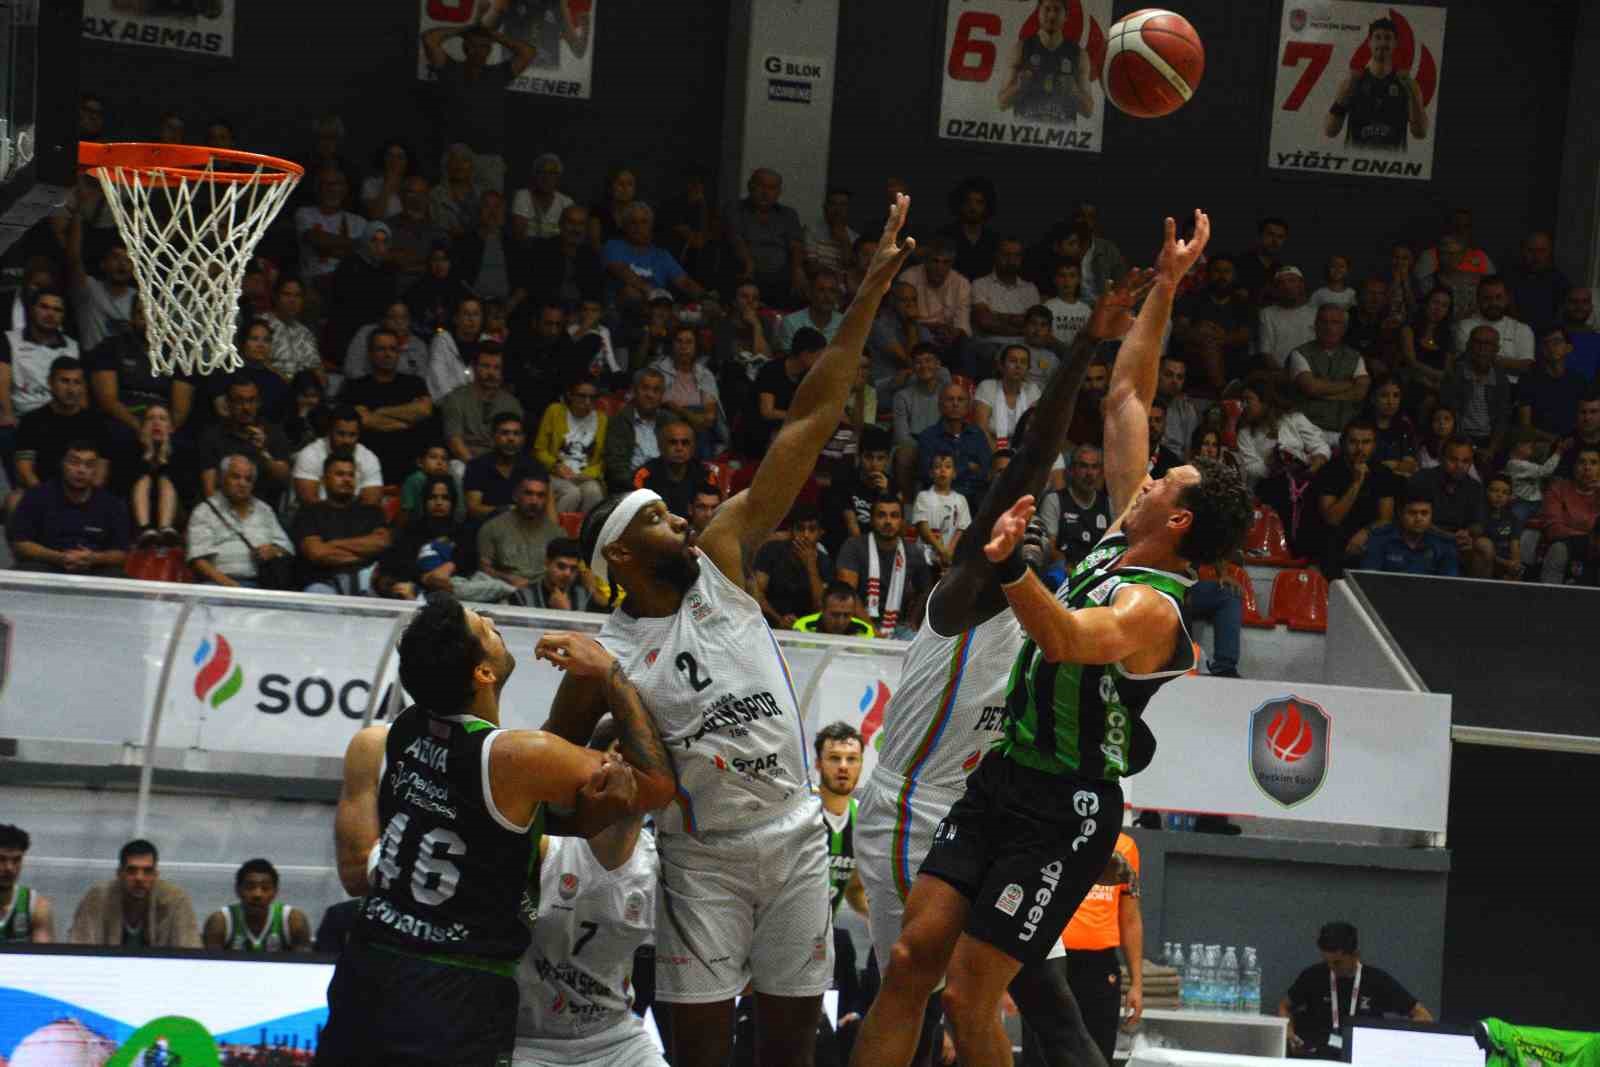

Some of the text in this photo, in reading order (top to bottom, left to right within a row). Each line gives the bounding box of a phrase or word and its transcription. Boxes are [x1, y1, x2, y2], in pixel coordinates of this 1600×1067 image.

[120, 21, 223, 52] ABMAS
[948, 11, 1002, 82] 6
[765, 56, 822, 78] G BLOK
[1281, 41, 1334, 112] 7
[510, 77, 582, 96] RENER
[946, 119, 1093, 149] OZAN YILMAZ
[1276, 150, 1423, 177] YİĞİT ONAN
[675, 651, 713, 692] 2
[732, 753, 778, 773] STAR
[378, 812, 467, 906] 16
[572, 920, 599, 957] 7
